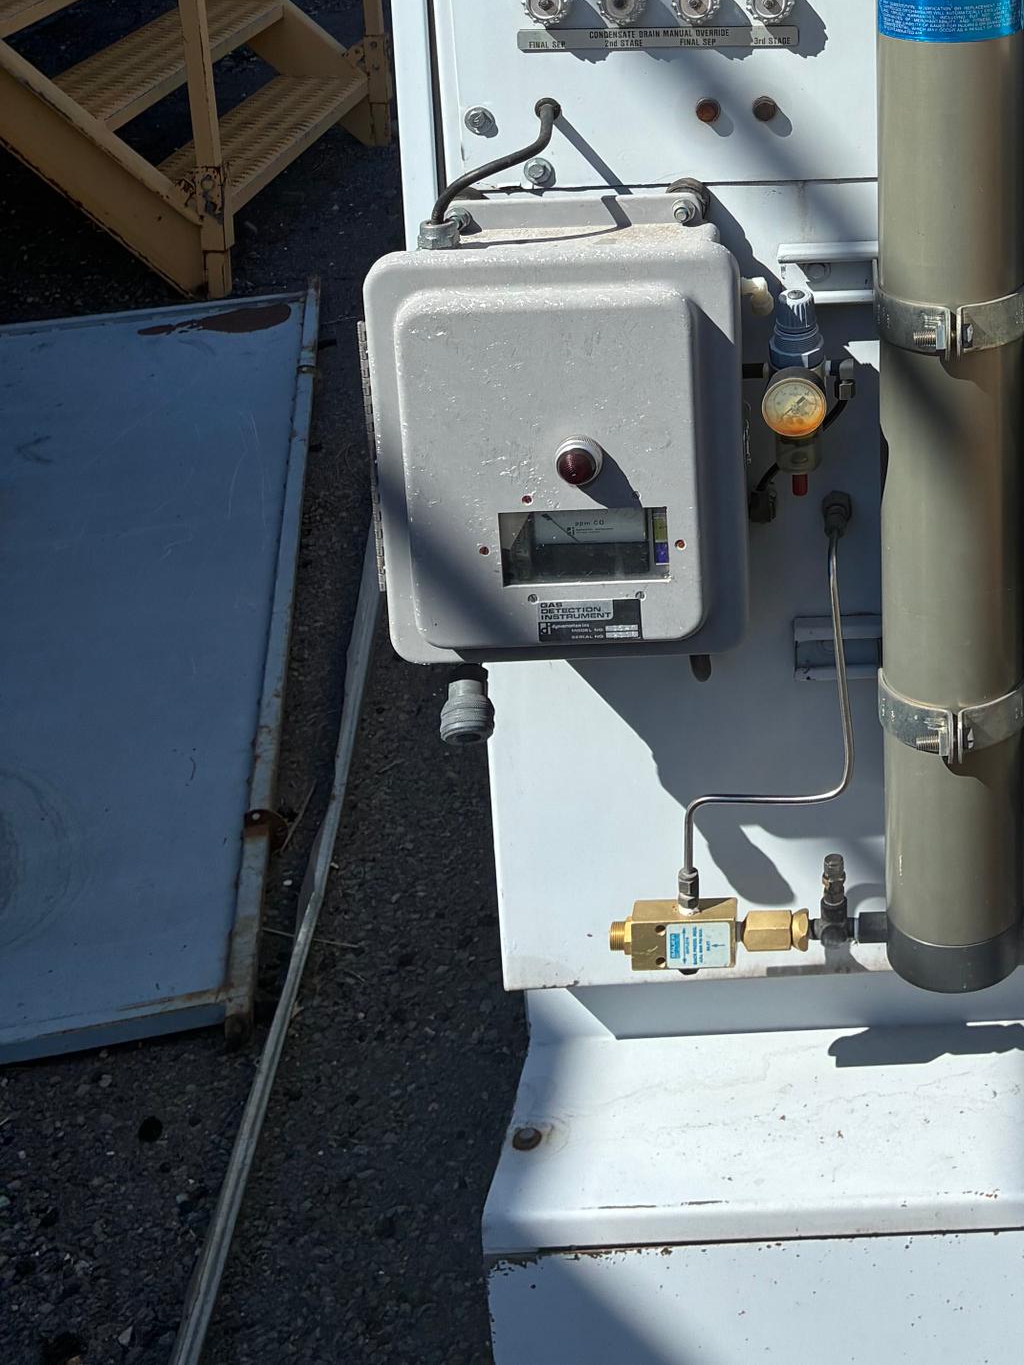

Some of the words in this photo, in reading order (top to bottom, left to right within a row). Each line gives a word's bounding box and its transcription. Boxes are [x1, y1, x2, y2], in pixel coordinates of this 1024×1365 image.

[589, 30, 636, 39] CONDENSATE
[663, 30, 693, 38] MANUAL
[696, 28, 730, 37] OVERRIDE
[529, 41, 549, 49] FINAL
[604, 39, 618, 48] 2nd
[620, 39, 643, 47] STAGE
[680, 39, 698, 47] FINAL
[702, 38, 717, 47] SEP
[754, 37, 766, 45] 3rd
[768, 37, 791, 45] STAGE
[541, 612, 611, 620] INSTRUMENT
